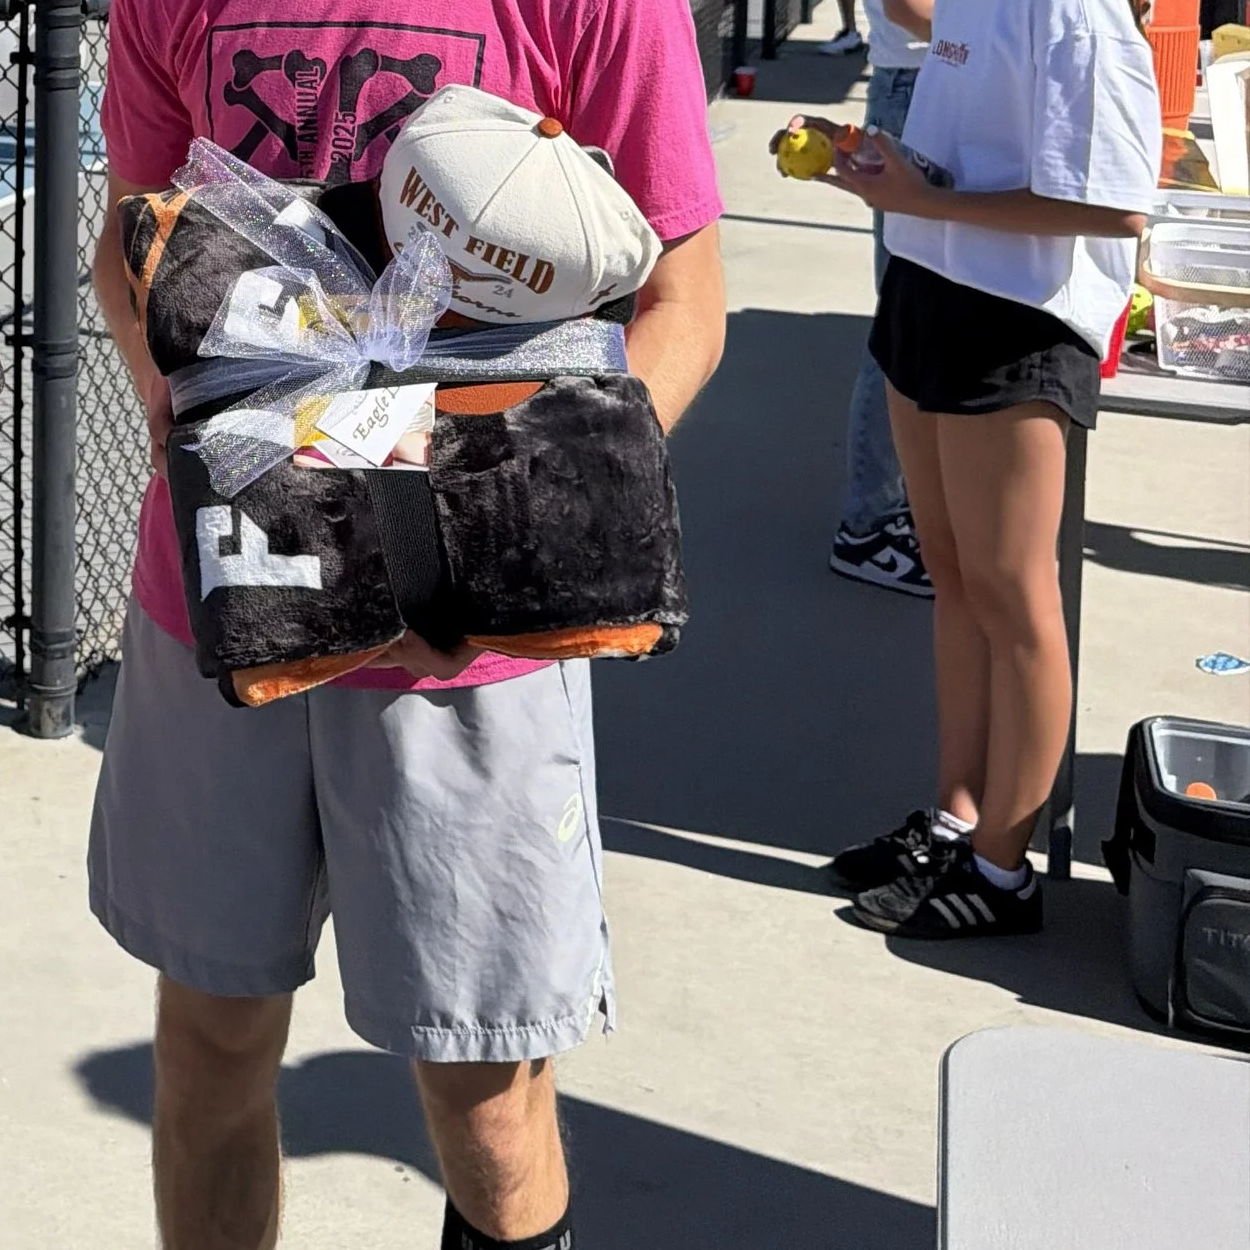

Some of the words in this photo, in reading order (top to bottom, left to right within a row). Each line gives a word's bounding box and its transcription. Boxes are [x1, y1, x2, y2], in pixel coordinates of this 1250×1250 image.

[295, 66, 320, 143] ANNUAL
[331, 111, 357, 163] 2025
[399, 166, 459, 238] WEST
[463, 235, 555, 294] FIELD
[493, 284, 514, 298] 24
[352, 391, 389, 441] Eagle
